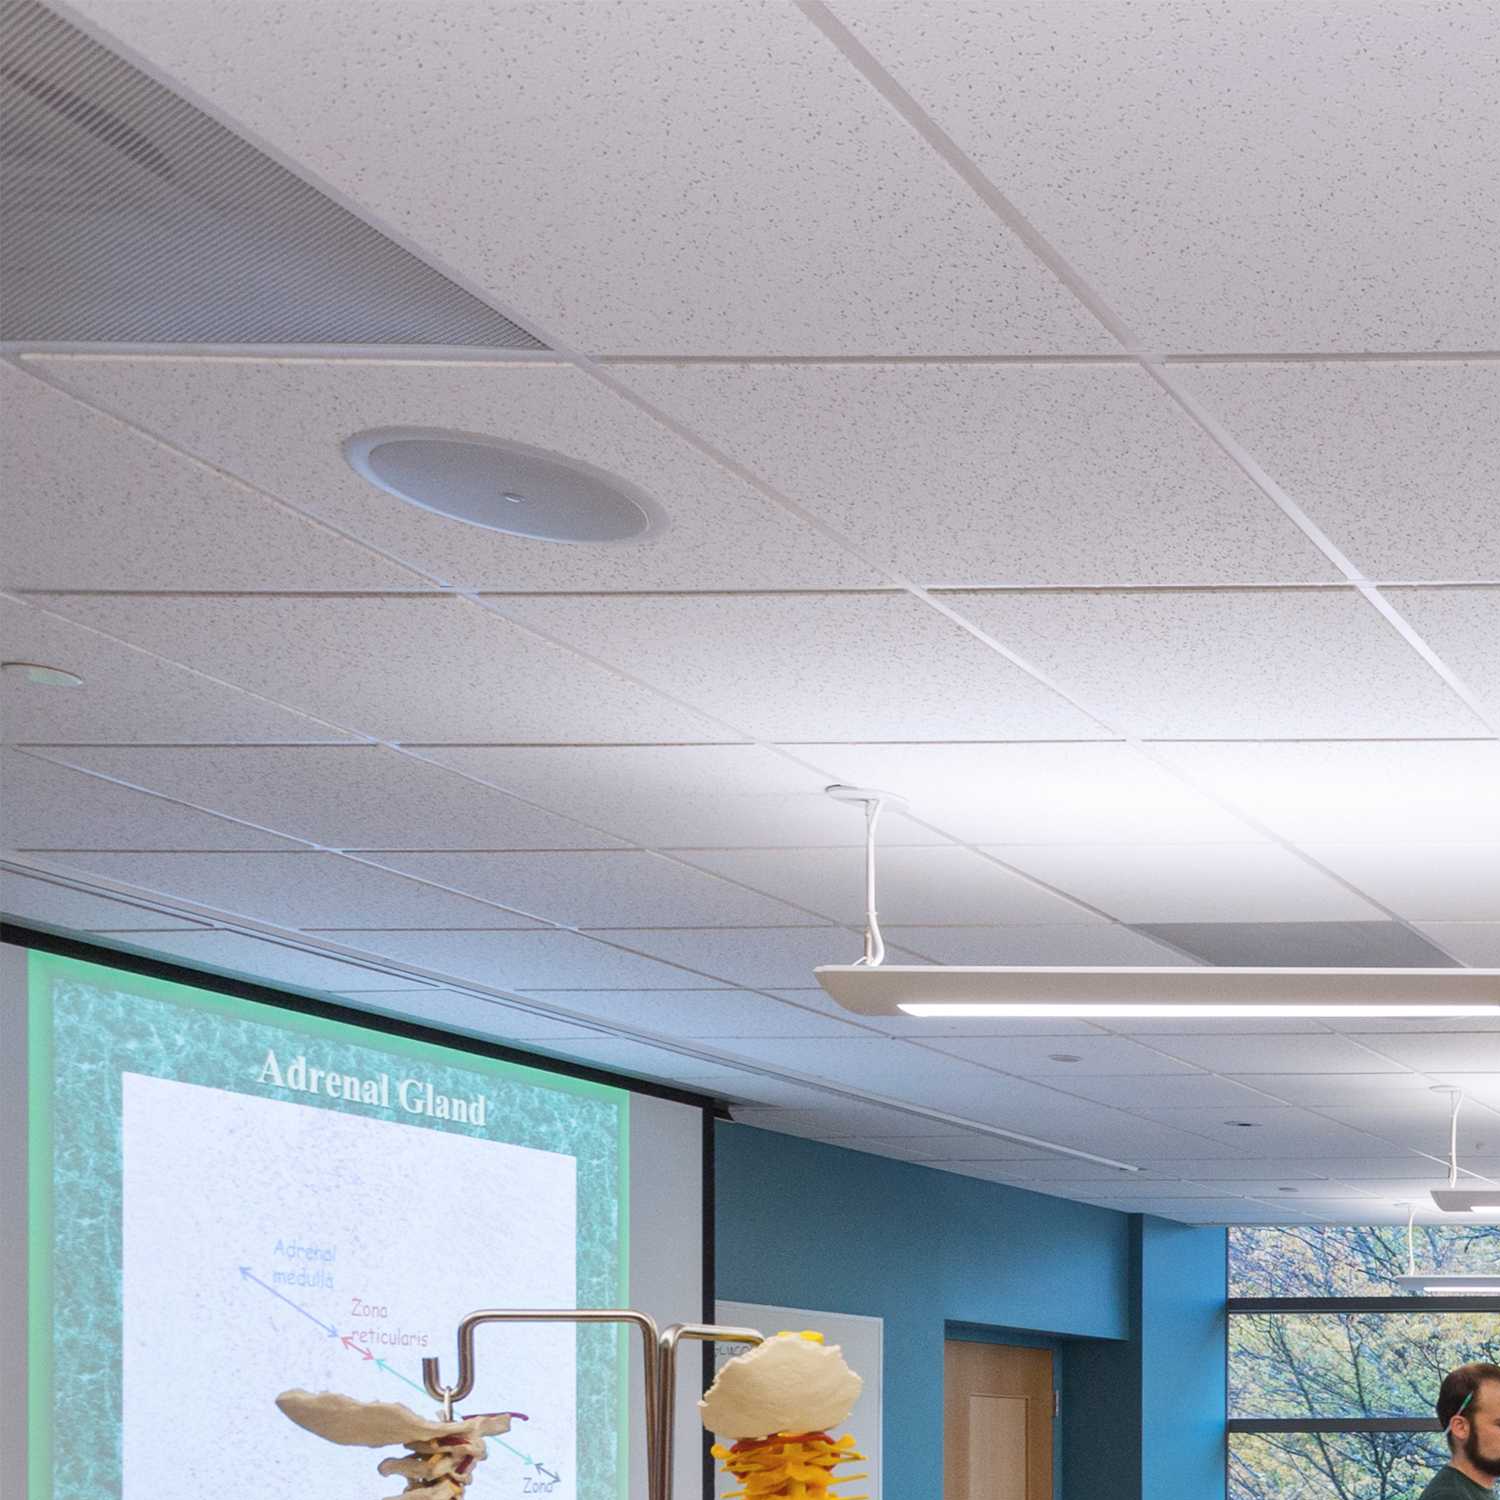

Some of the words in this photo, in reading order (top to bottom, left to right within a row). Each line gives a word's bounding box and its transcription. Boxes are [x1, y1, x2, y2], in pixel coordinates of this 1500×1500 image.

[256, 1050, 392, 1109] Adrenal
[399, 1079, 486, 1127] Gland
[273, 1239, 337, 1263] Adrenal
[272, 1266, 334, 1289] medulla
[351, 1297, 388, 1319] Zona
[351, 1327, 430, 1348] reticularis
[523, 1477, 554, 1494] Zona
